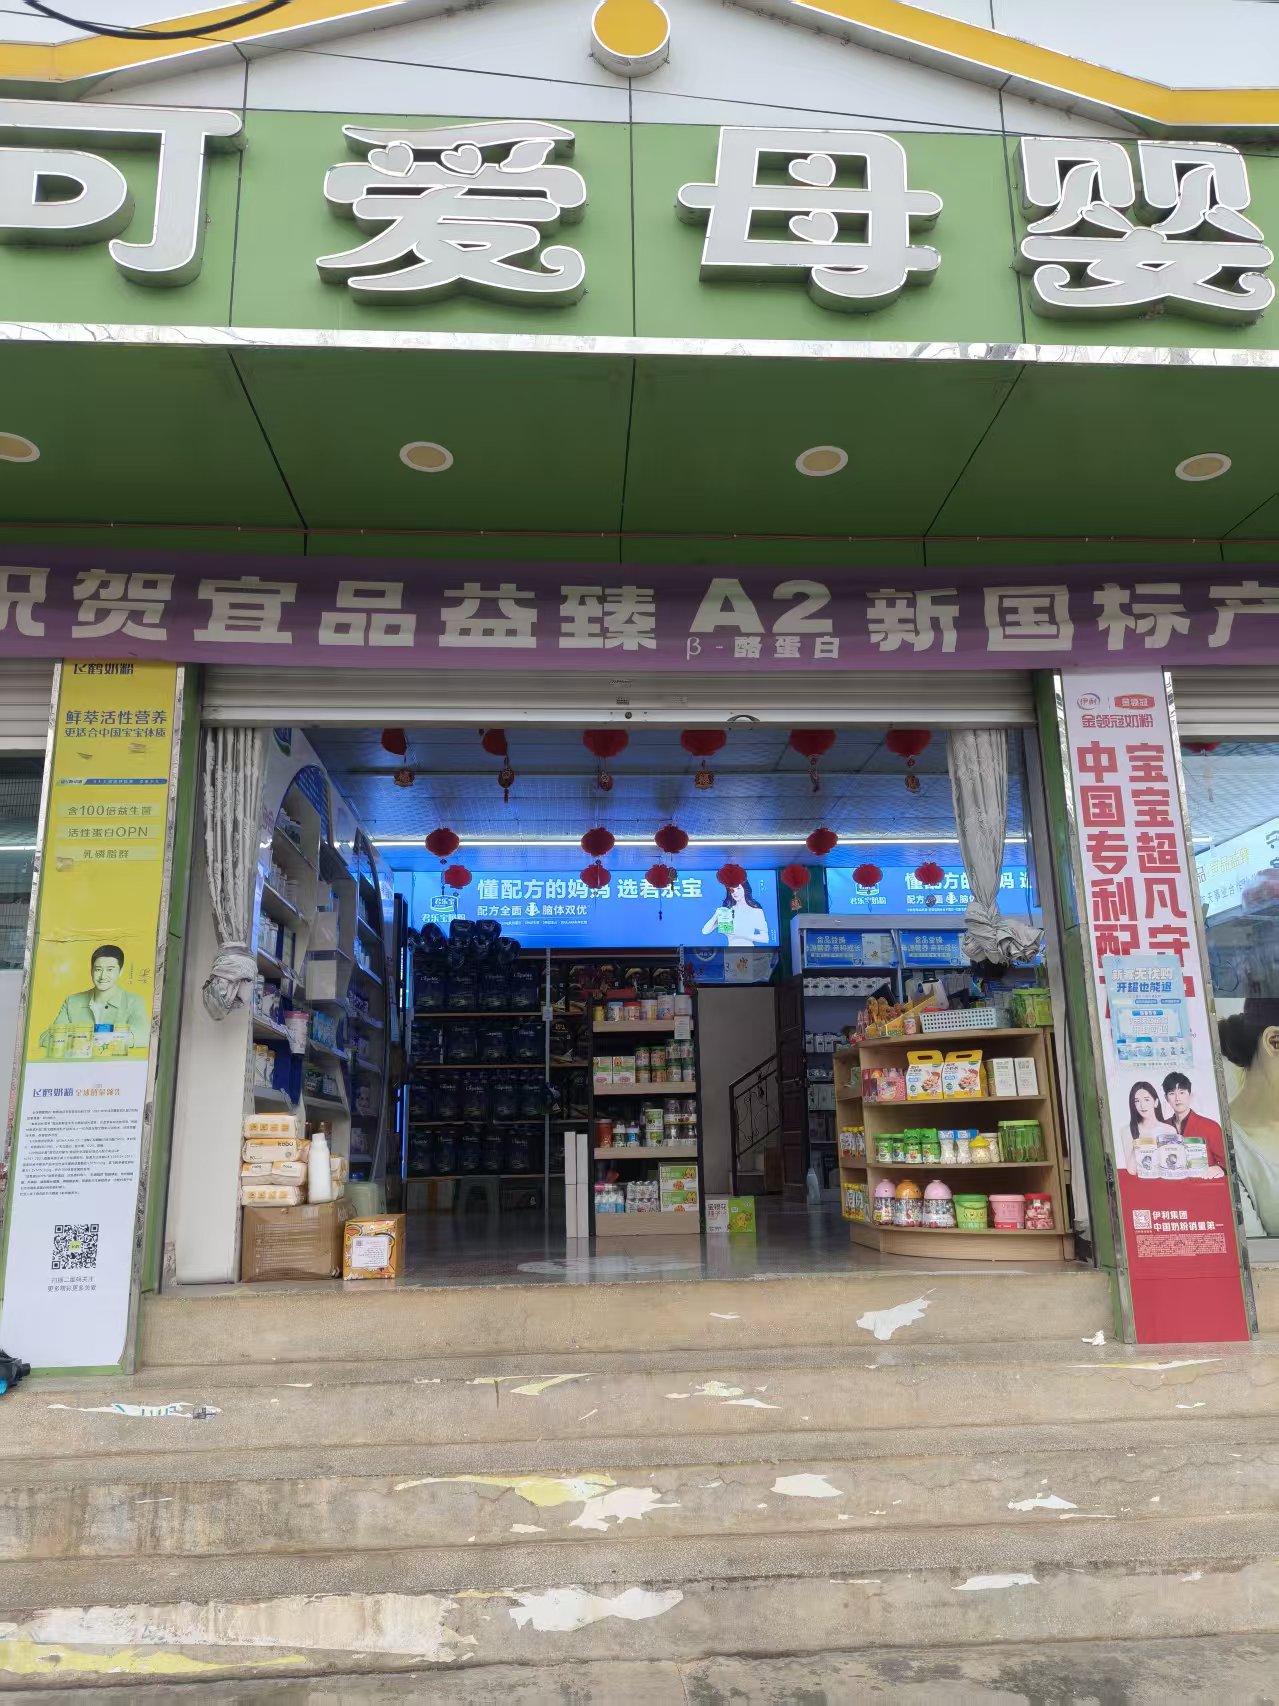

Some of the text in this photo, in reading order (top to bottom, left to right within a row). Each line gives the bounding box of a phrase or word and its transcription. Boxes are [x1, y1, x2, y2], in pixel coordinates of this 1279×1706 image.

[0, 98, 1276, 312] 可爱母婴
[65, 710, 168, 725] 鲜萃活性营养
[1081, 714, 1154, 728] 金领冠奶粉
[64, 727, 166, 738] 更适合中国宝宝体质
[67, 805, 153, 817] 含100倍益生菌
[68, 826, 149, 838] 活性蛋白OPN
[83, 849, 129, 860] 乳磷脂群
[1125, 743, 1196, 997] 宝宝超凡守
[906, 895, 944, 904] 配方面
[477, 904, 588, 917] 配方全面 脑体双优
[1116, 981, 1172, 993] 开罐也能退
[1152, 1210, 1188, 1221] 伊利集团
[1153, 1221, 1224, 1232] 中国奶粉销量第一
